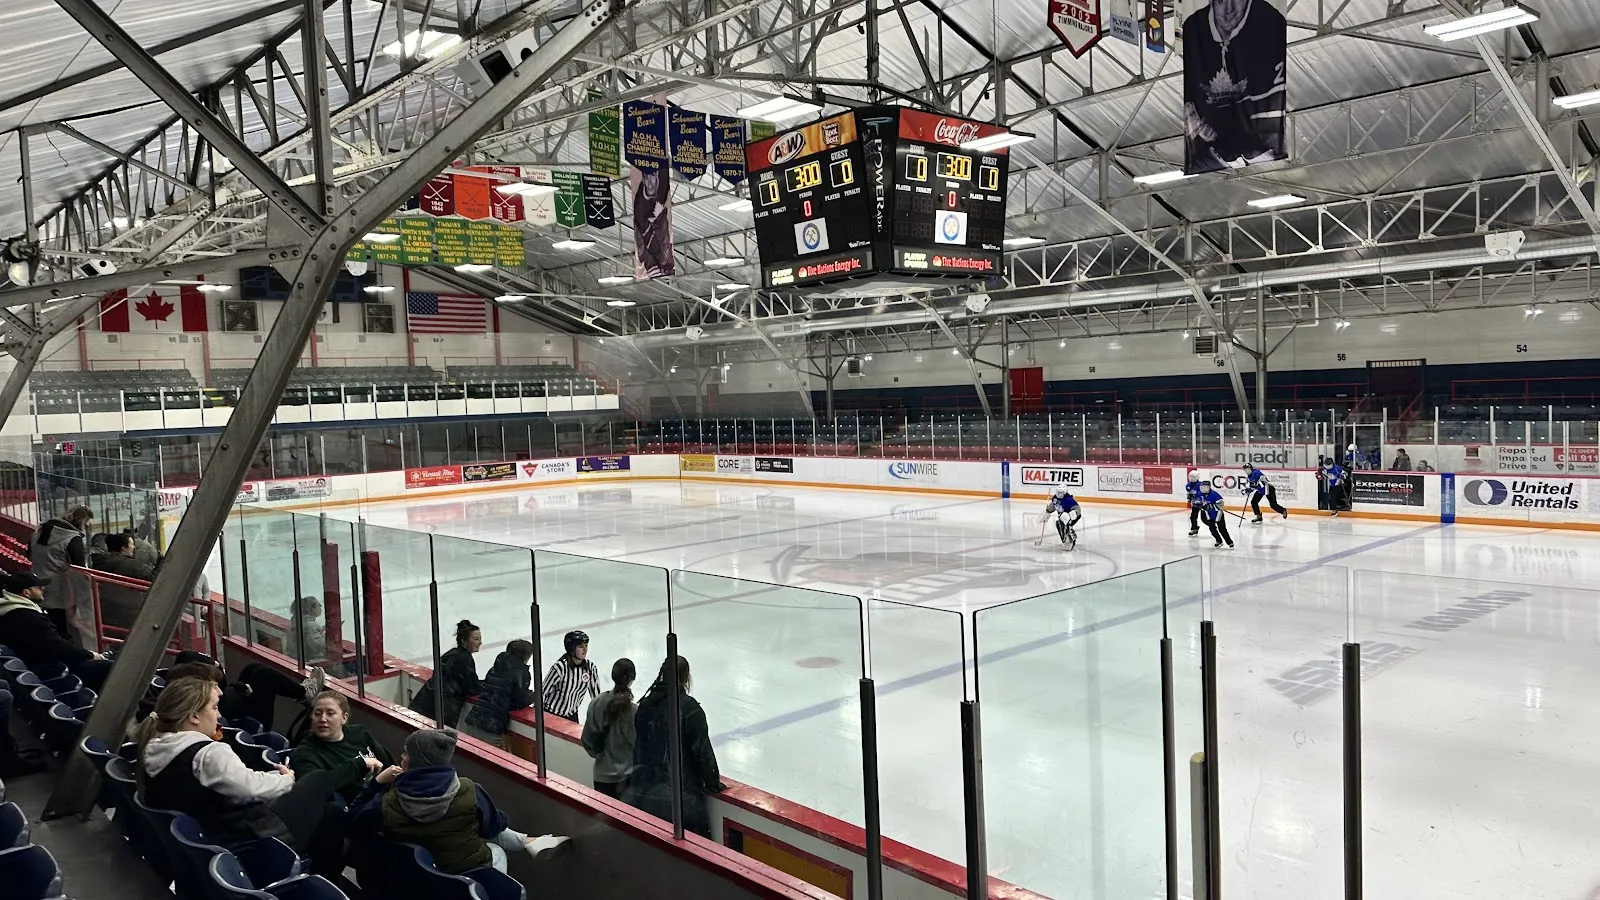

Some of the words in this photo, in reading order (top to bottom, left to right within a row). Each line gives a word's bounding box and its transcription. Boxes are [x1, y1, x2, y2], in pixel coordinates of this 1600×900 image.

[1061, 3, 1091, 24] 2002
[1058, 15, 1078, 28] TIMMINS
[636, 116, 655, 128] Bears
[680, 123, 698, 135] Bears
[626, 143, 665, 156] CHAMPIONS
[630, 138, 661, 149] JUVENILE
[676, 144, 704, 154] ONTARIO
[773, 132, 803, 163] A&W
[673, 156, 709, 166] CHAMPIONS
[676, 151, 705, 160] JUVENILE
[830, 149, 849, 161] GUEST
[981, 156, 998, 166] GUEST
[634, 158, 660, 169] 1968-69
[917, 158, 926, 180] 0
[945, 154, 970, 178] 3:00
[679, 166, 703, 175] 1969-70
[794, 163, 821, 189] 3:00
[841, 160, 852, 183] 0
[873, 138, 885, 232] POWERADE
[989, 168, 998, 190] 0
[768, 181, 779, 202] 0
[824, 193, 841, 202] PLAYER
[948, 190, 956, 207] 0
[755, 210, 769, 219] PLAYER
[803, 200, 812, 217] 0
[835, 260, 852, 273] Energy
[969, 257, 985, 271] Energy
[1516, 344, 1528, 353] 54
[1216, 359, 1225, 367] 56
[1337, 353, 1346, 361] 56
[541, 461, 570, 469] CANADA'S
[718, 459, 740, 469] CORE
[897, 462, 938, 476] SUNWIRE
[1099, 474, 1124, 484] Claim
[1212, 475, 1247, 490] COR
[1511, 480, 1574, 495] United
[1511, 494, 1579, 510] Rentals
